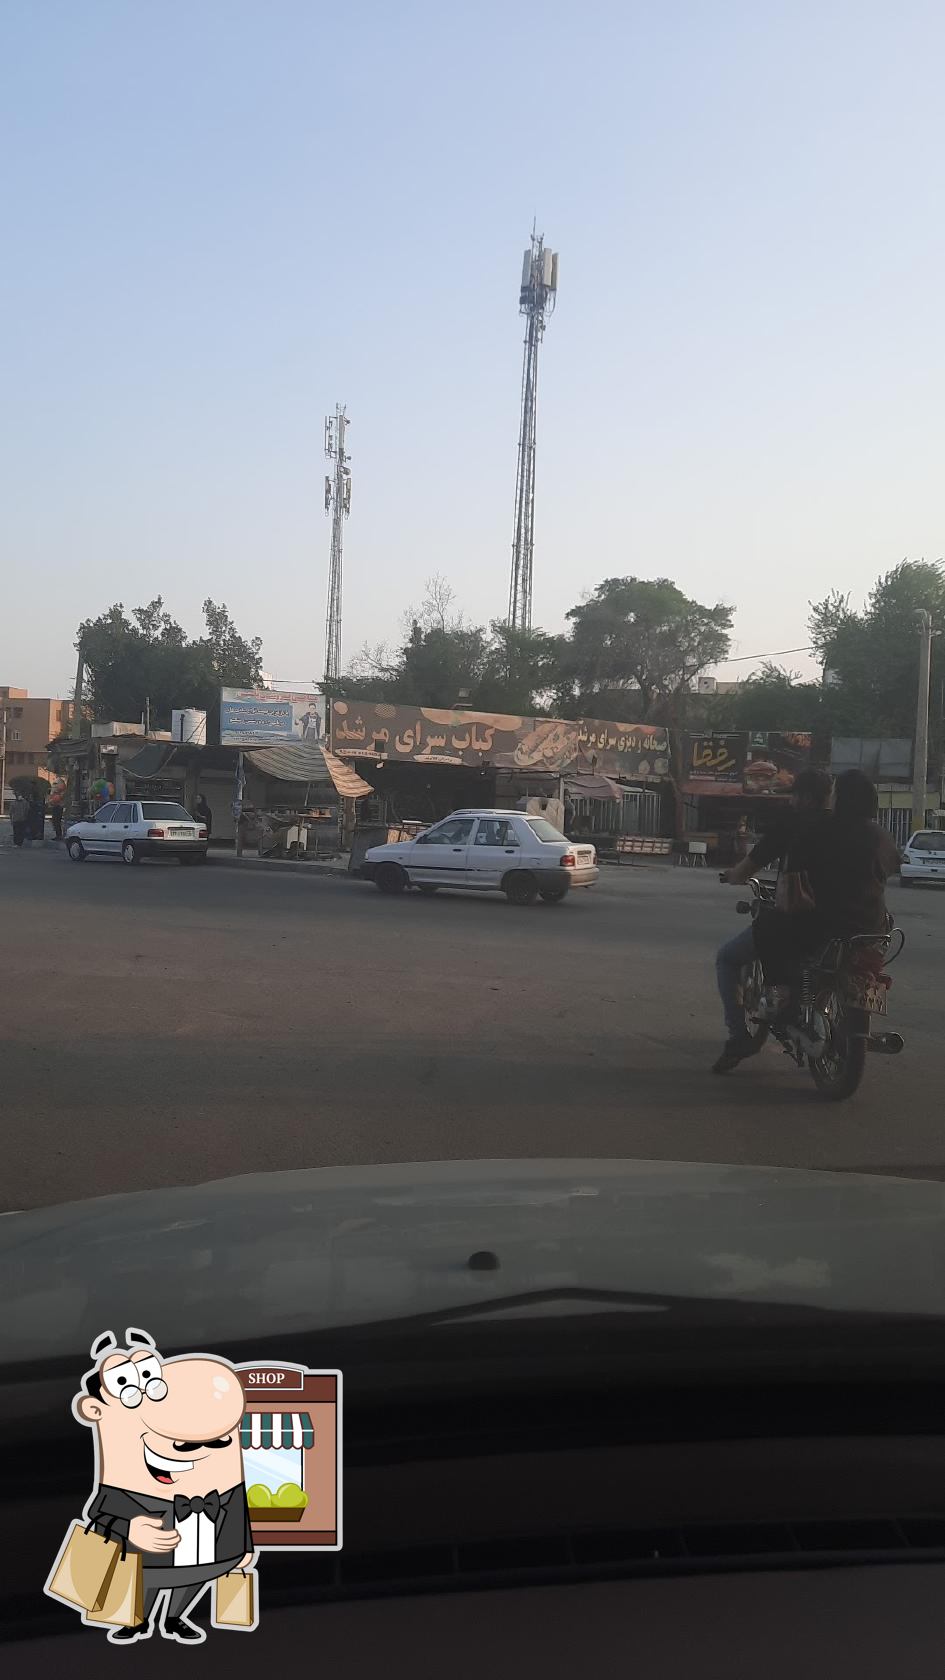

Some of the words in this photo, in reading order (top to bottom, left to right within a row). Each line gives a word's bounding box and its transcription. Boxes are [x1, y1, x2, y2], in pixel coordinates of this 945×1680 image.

[335, 716, 389, 751] مرشد
[396, 720, 446, 754] سرای
[452, 724, 495, 757] کباب
[598, 728, 616, 751] سرای
[618, 734, 636, 753] دیزی
[693, 740, 736, 771] رفقا
